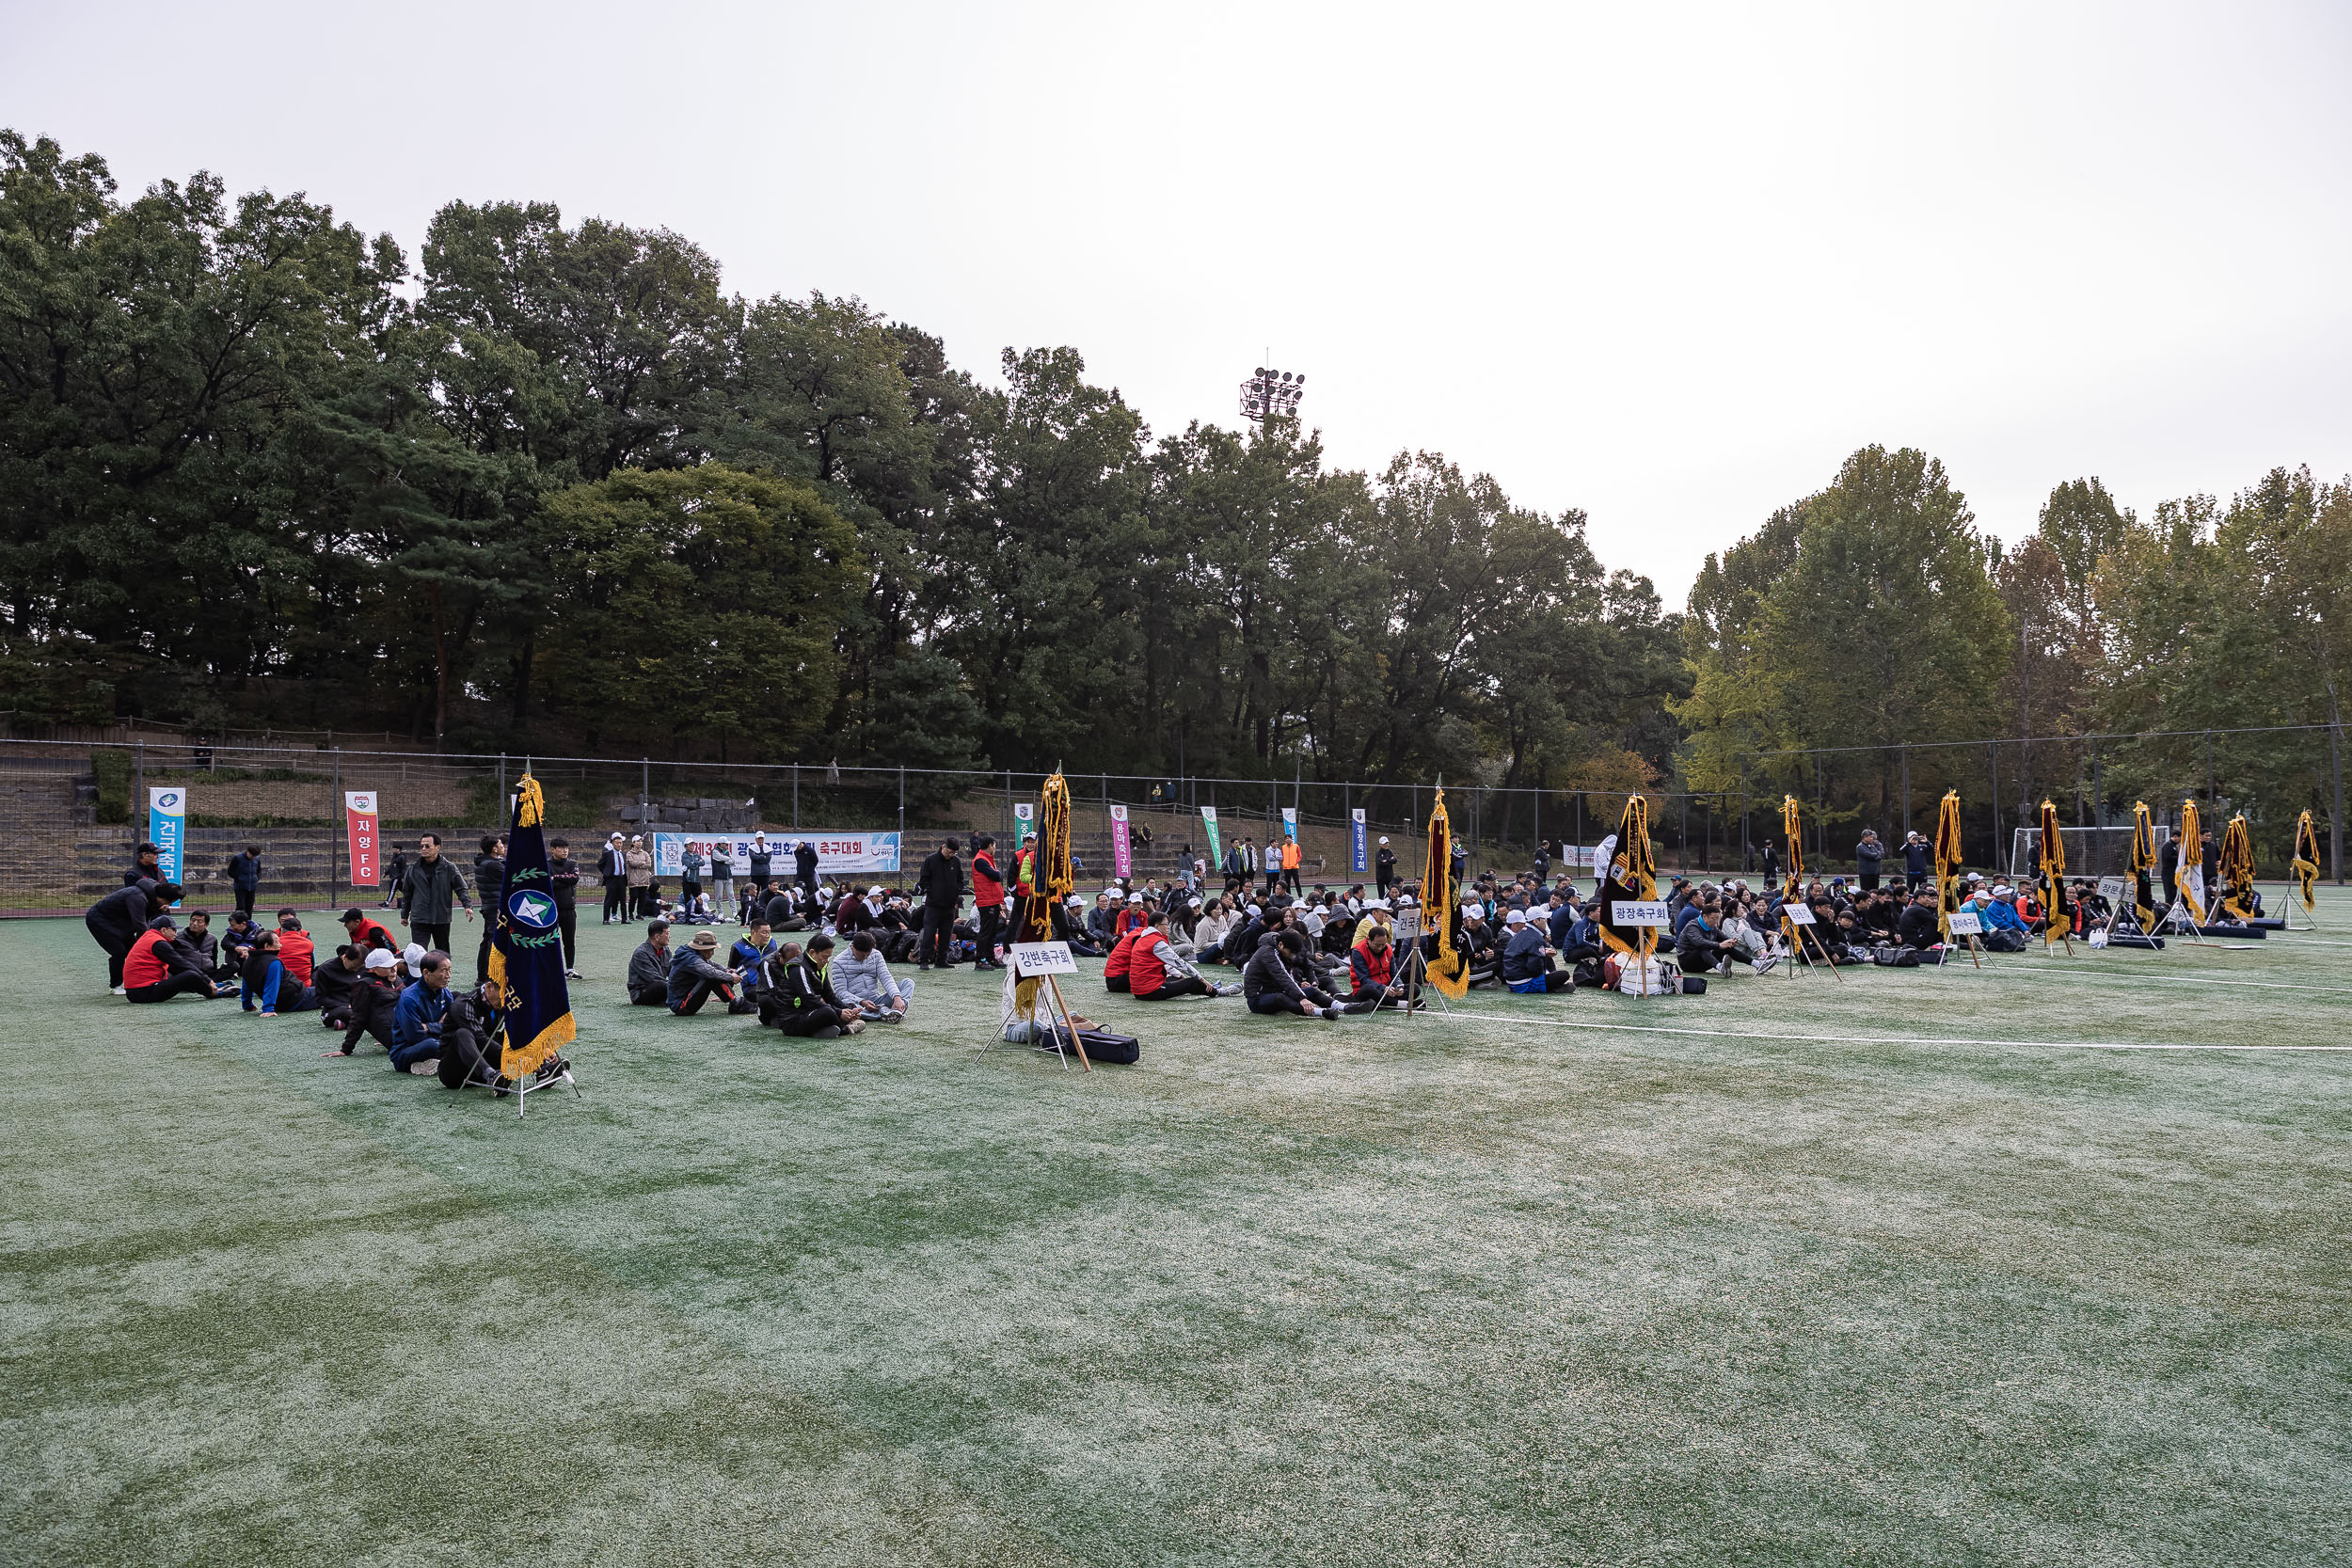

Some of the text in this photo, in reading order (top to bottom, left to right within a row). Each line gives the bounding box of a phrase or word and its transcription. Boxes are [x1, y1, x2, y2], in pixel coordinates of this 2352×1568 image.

[819, 842, 862, 855] 축구대회
[1116, 823, 1129, 875] 용마축구회
[1357, 825, 1365, 870] 광장축구회
[1615, 908, 1666, 920] 광장축구회
[1019, 949, 1072, 968] 강변축구회
